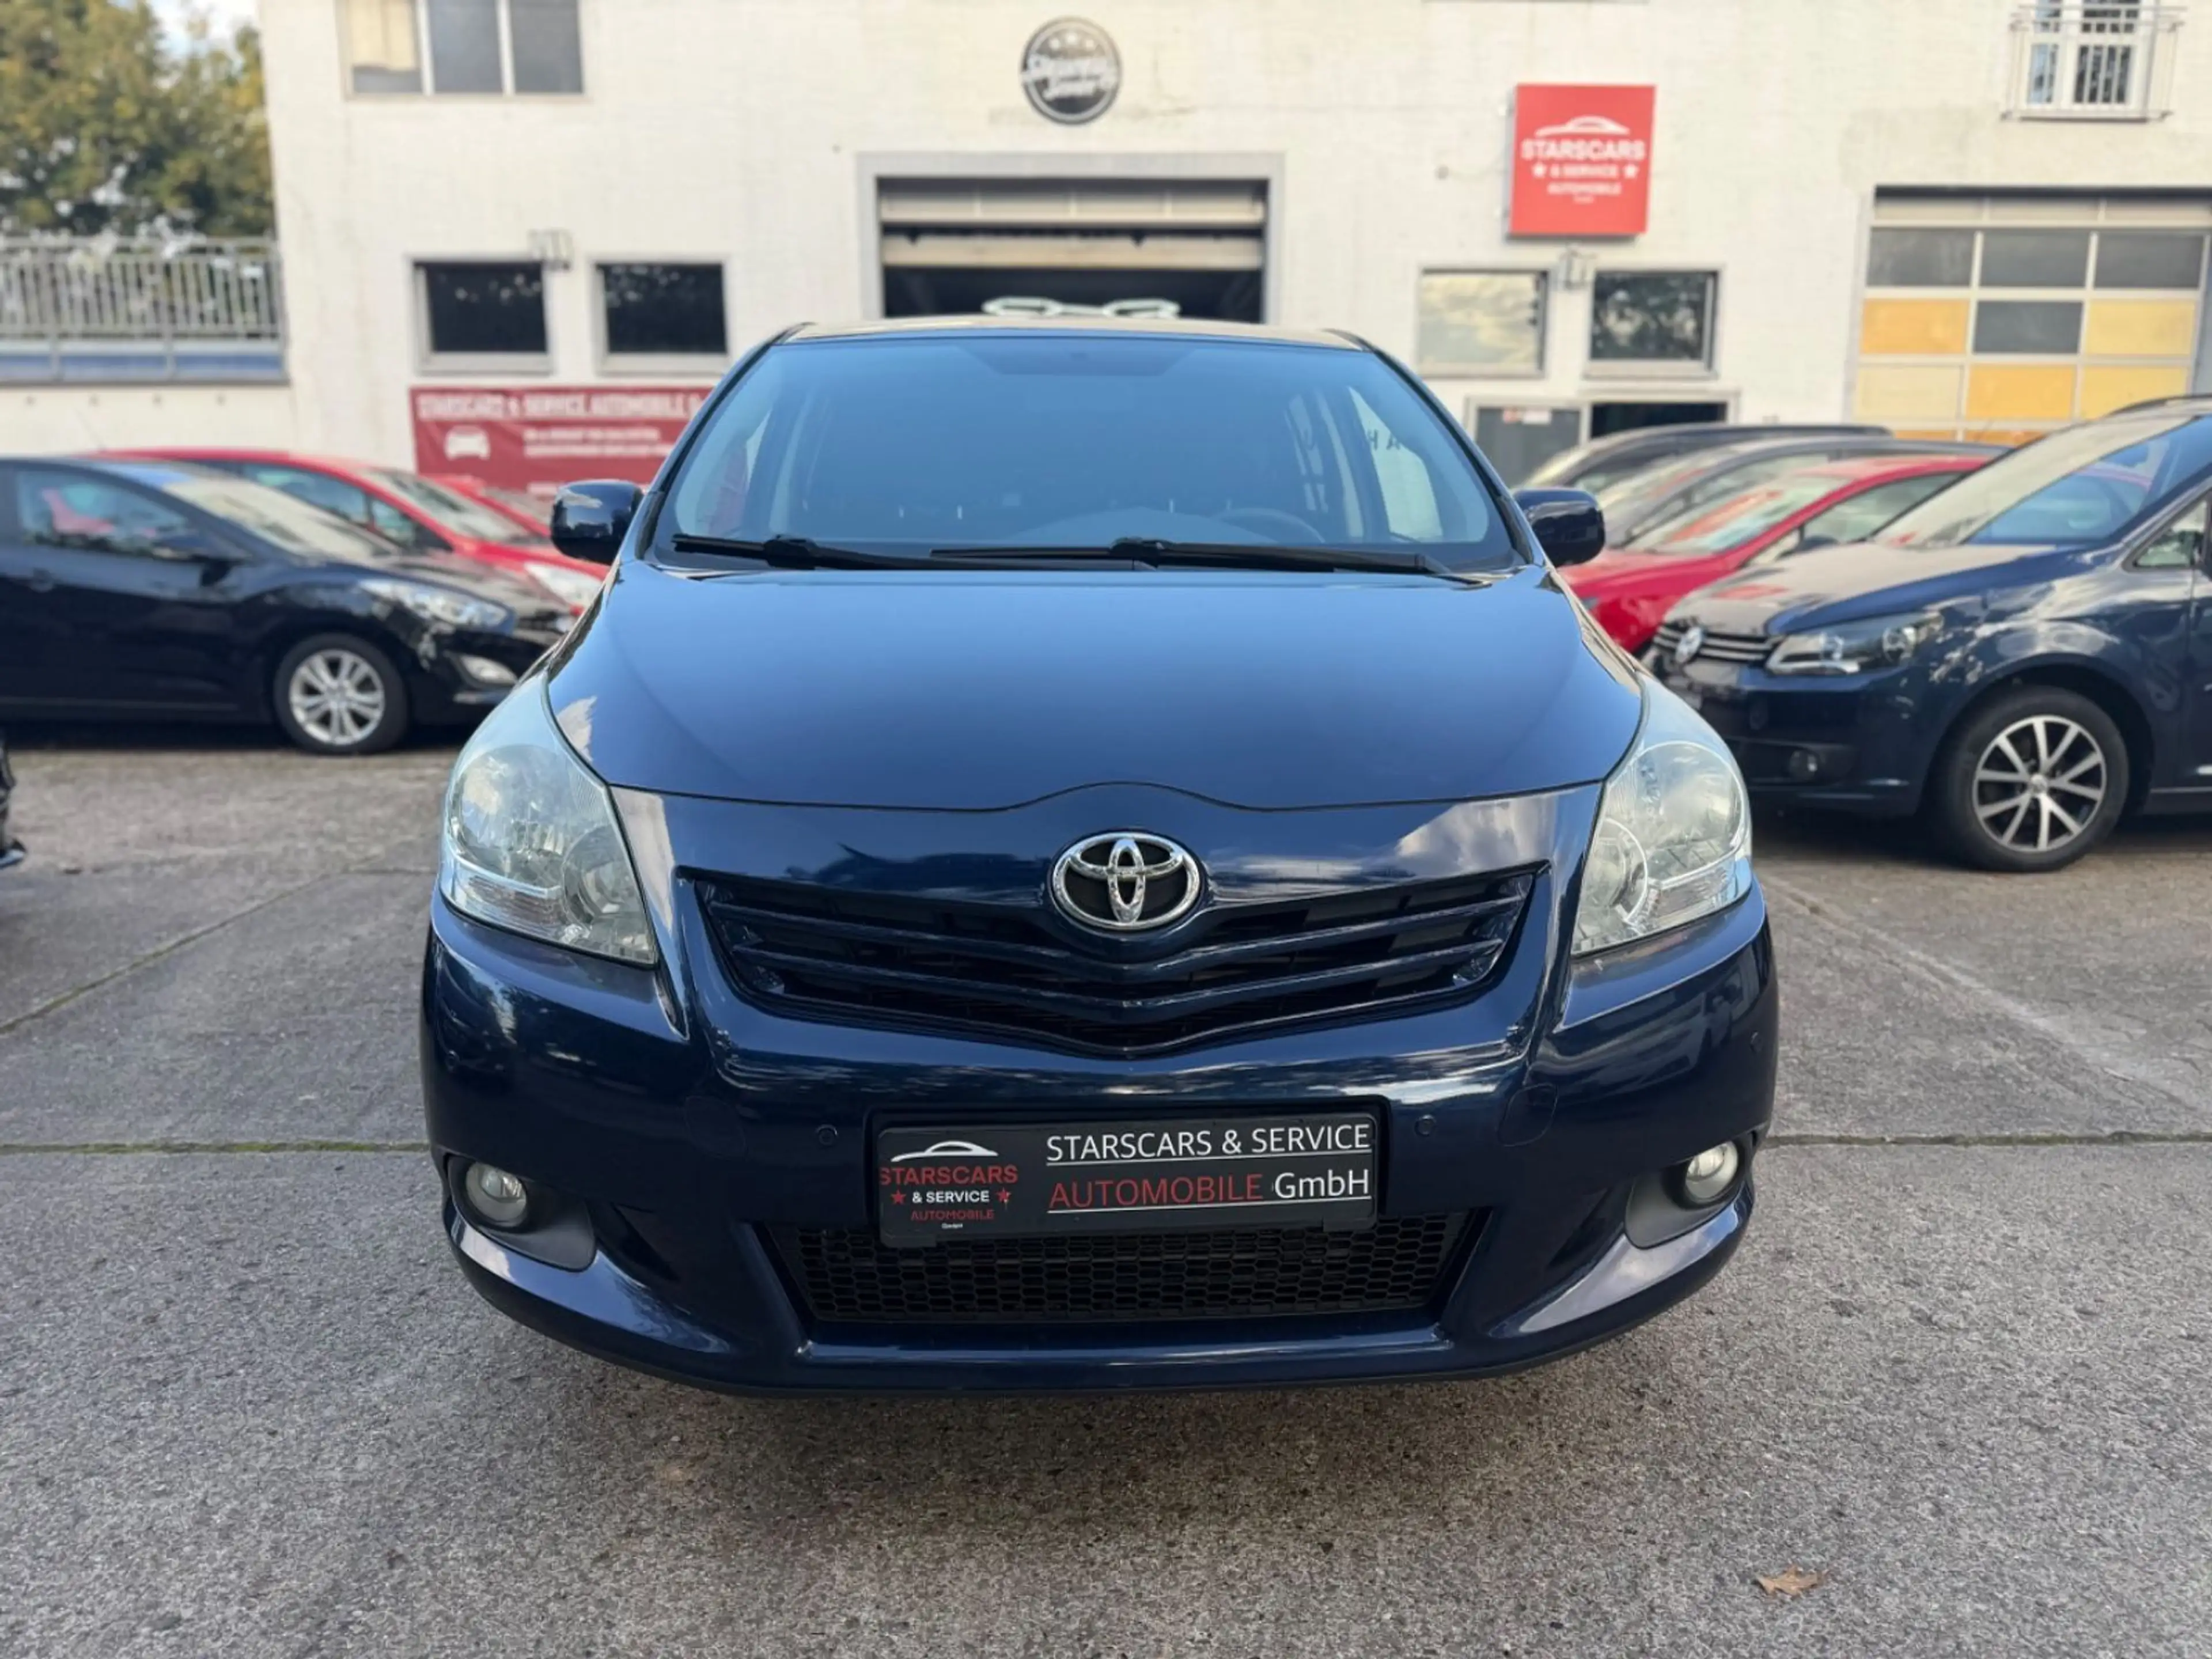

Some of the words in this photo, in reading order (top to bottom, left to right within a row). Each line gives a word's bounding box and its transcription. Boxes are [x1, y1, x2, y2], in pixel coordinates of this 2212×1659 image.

[1521, 138, 1645, 161] STARSCARS
[1046, 1130, 1212, 1162] STARSCARS
[1222, 1130, 1243, 1155] &
[1251, 1124, 1370, 1153] SERVICE
[880, 1164, 1018, 1187] STARSCARS
[912, 1190, 923, 1204] &
[926, 1189, 990, 1204] SERVICE
[1048, 1173, 1263, 1209] AUTOMOBILE
[1274, 1168, 1370, 1200] GmbH
[910, 1209, 995, 1222] AUTOMOBILE
